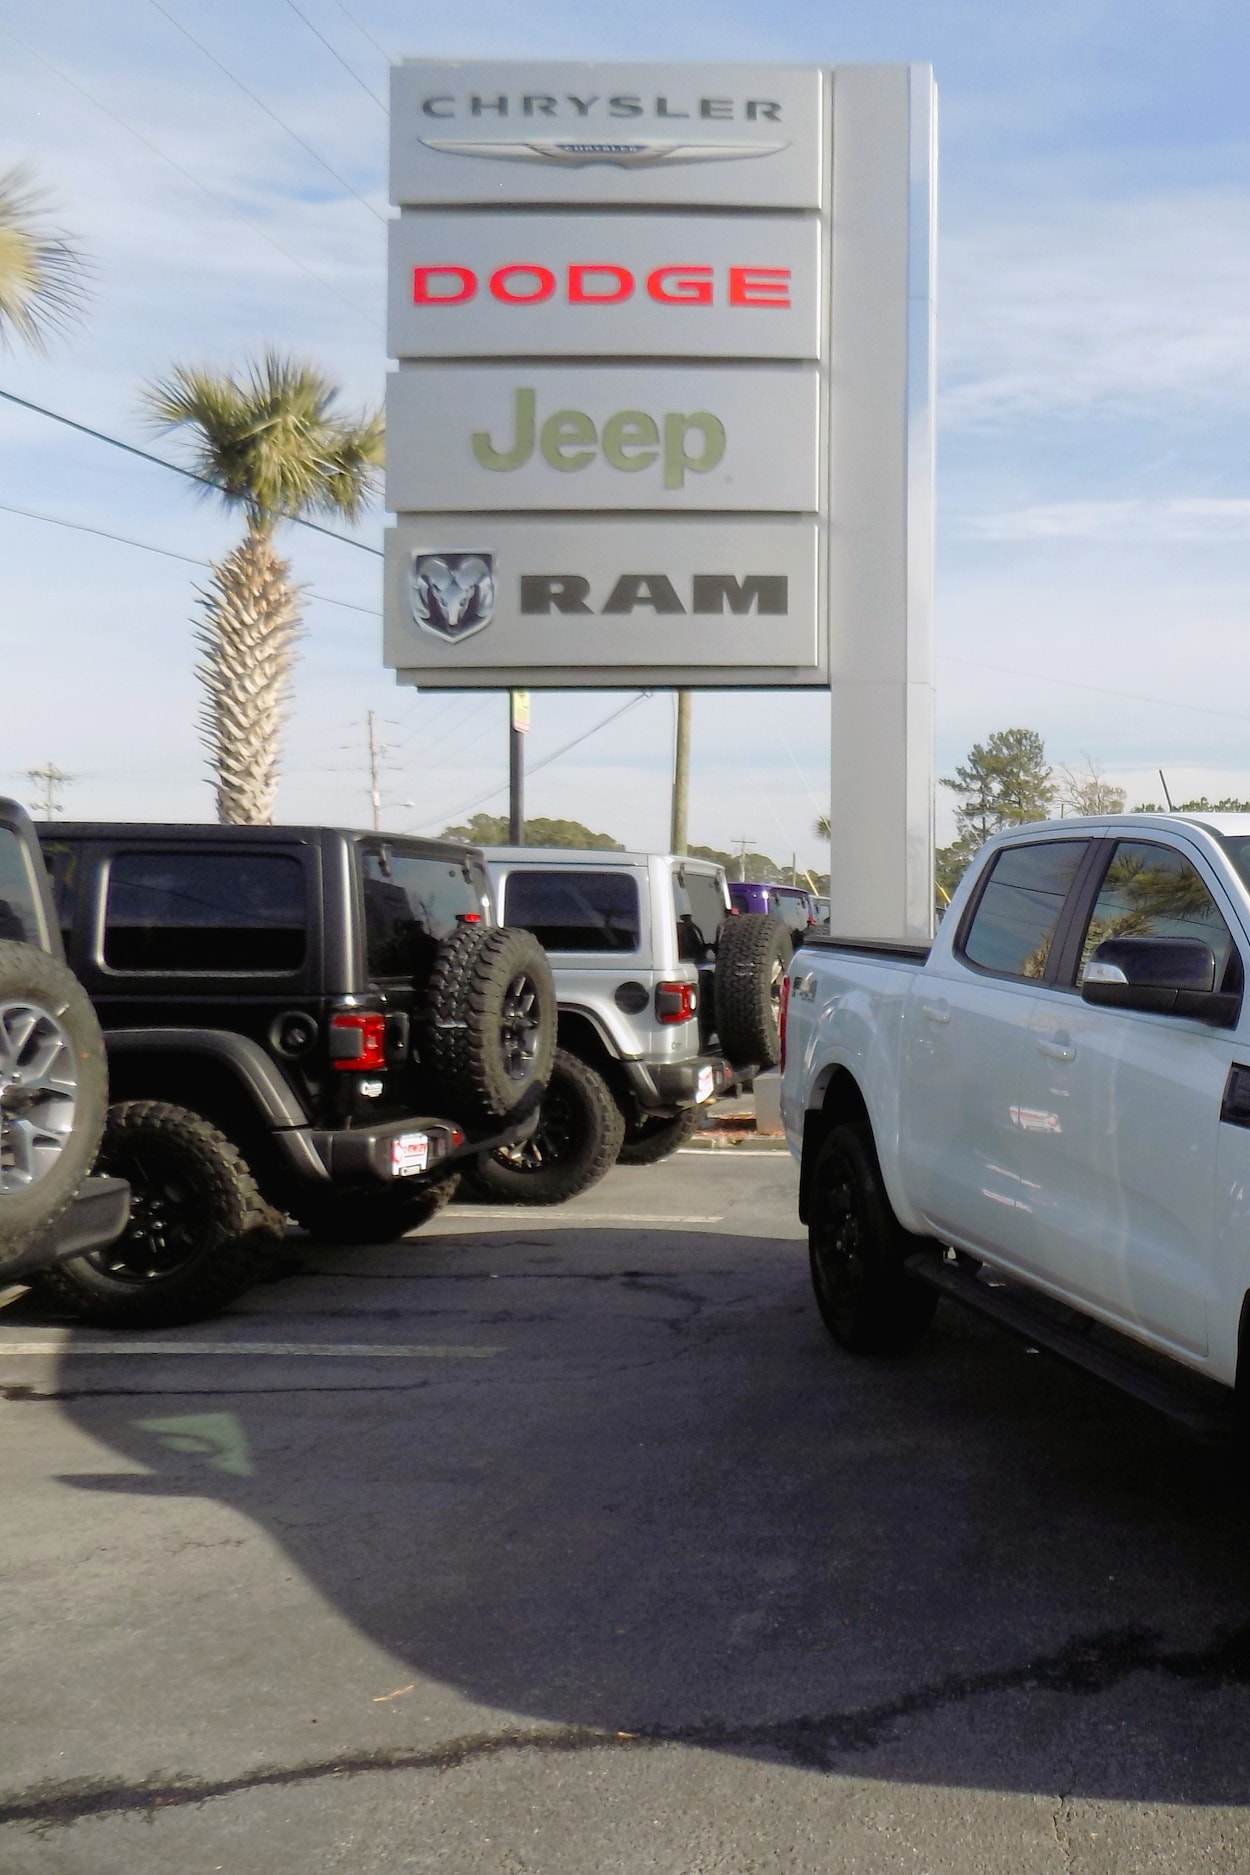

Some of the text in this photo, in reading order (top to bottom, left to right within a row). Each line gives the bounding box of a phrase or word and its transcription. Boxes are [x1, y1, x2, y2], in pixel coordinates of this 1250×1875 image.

[421, 94, 784, 123] CHRYSLER
[412, 264, 792, 309] DODGE
[471, 387, 726, 490] Jeep
[519, 574, 789, 616] RAM
